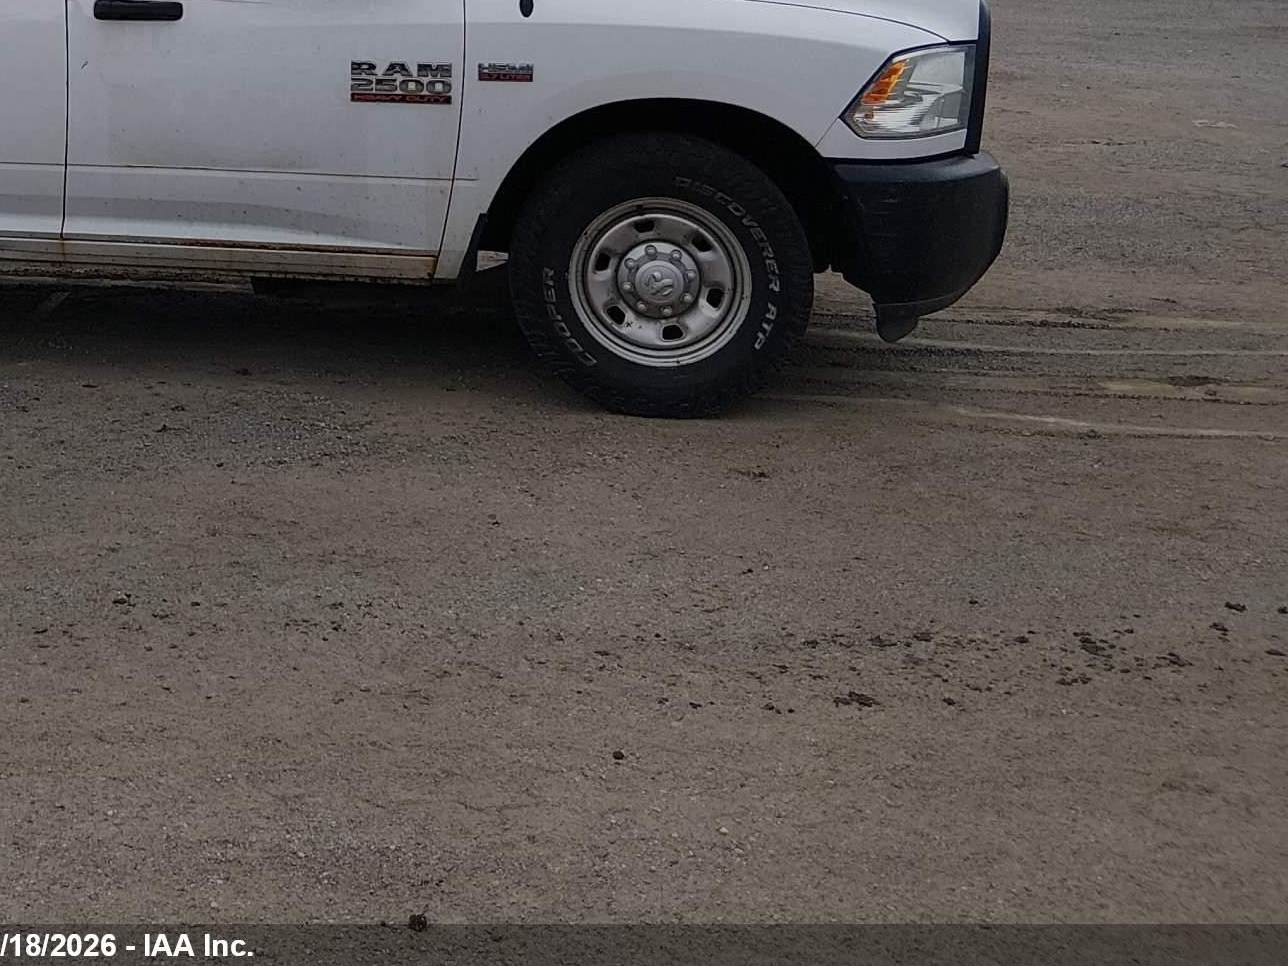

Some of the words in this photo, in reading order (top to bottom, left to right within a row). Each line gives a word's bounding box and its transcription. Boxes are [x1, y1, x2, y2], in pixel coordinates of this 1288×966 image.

[351, 61, 452, 78] RAM
[351, 78, 452, 94] 2500
[353, 94, 402, 102] HEAVY
[405, 95, 448, 103] DUTY
